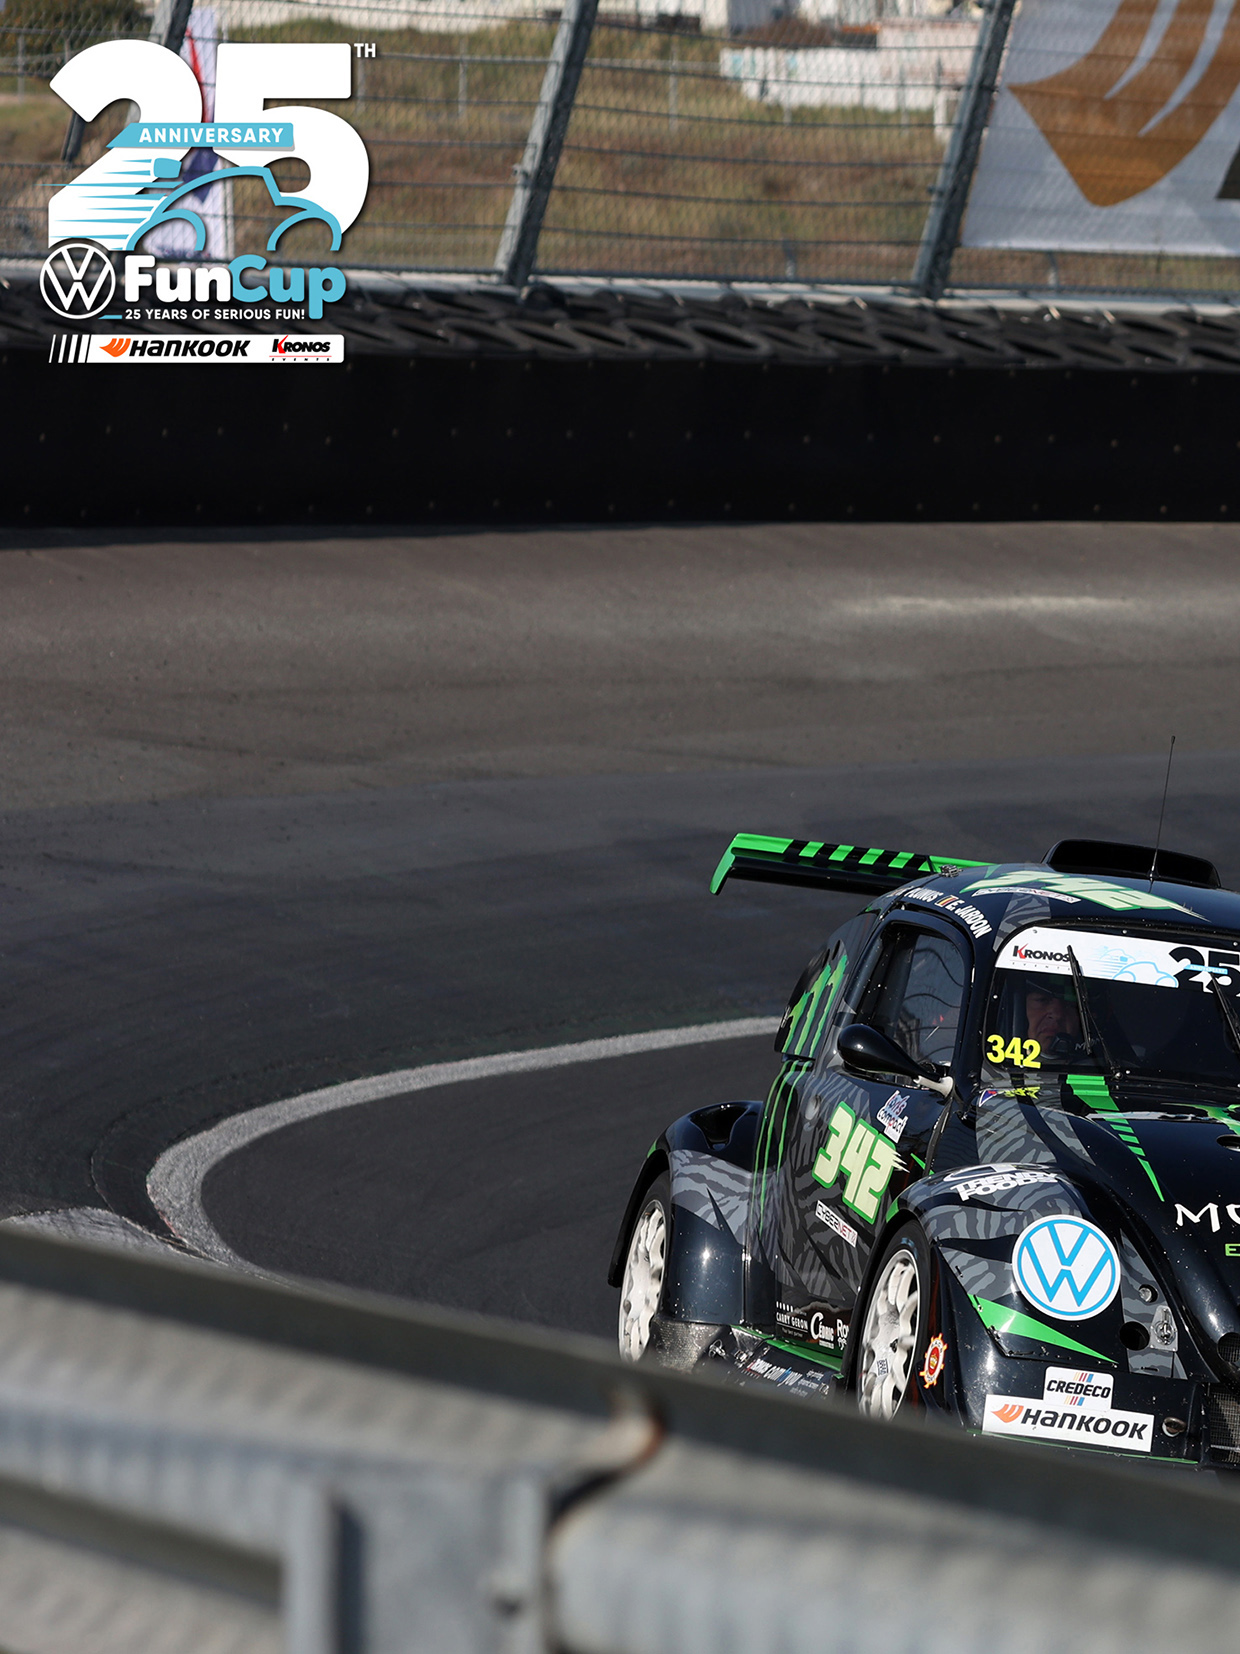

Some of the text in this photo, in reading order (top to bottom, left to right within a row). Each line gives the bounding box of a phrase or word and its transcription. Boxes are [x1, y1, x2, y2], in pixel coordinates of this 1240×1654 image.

[954, 905, 993, 939] JARDON
[1012, 943, 1071, 963] KRONOS
[986, 1034, 1041, 1069] 342
[812, 1100, 902, 1225] 342
[949, 1172, 1059, 1192] TRENDY
[958, 1176, 1059, 1202] FOODS
[1046, 1379, 1111, 1399] CREDECO
